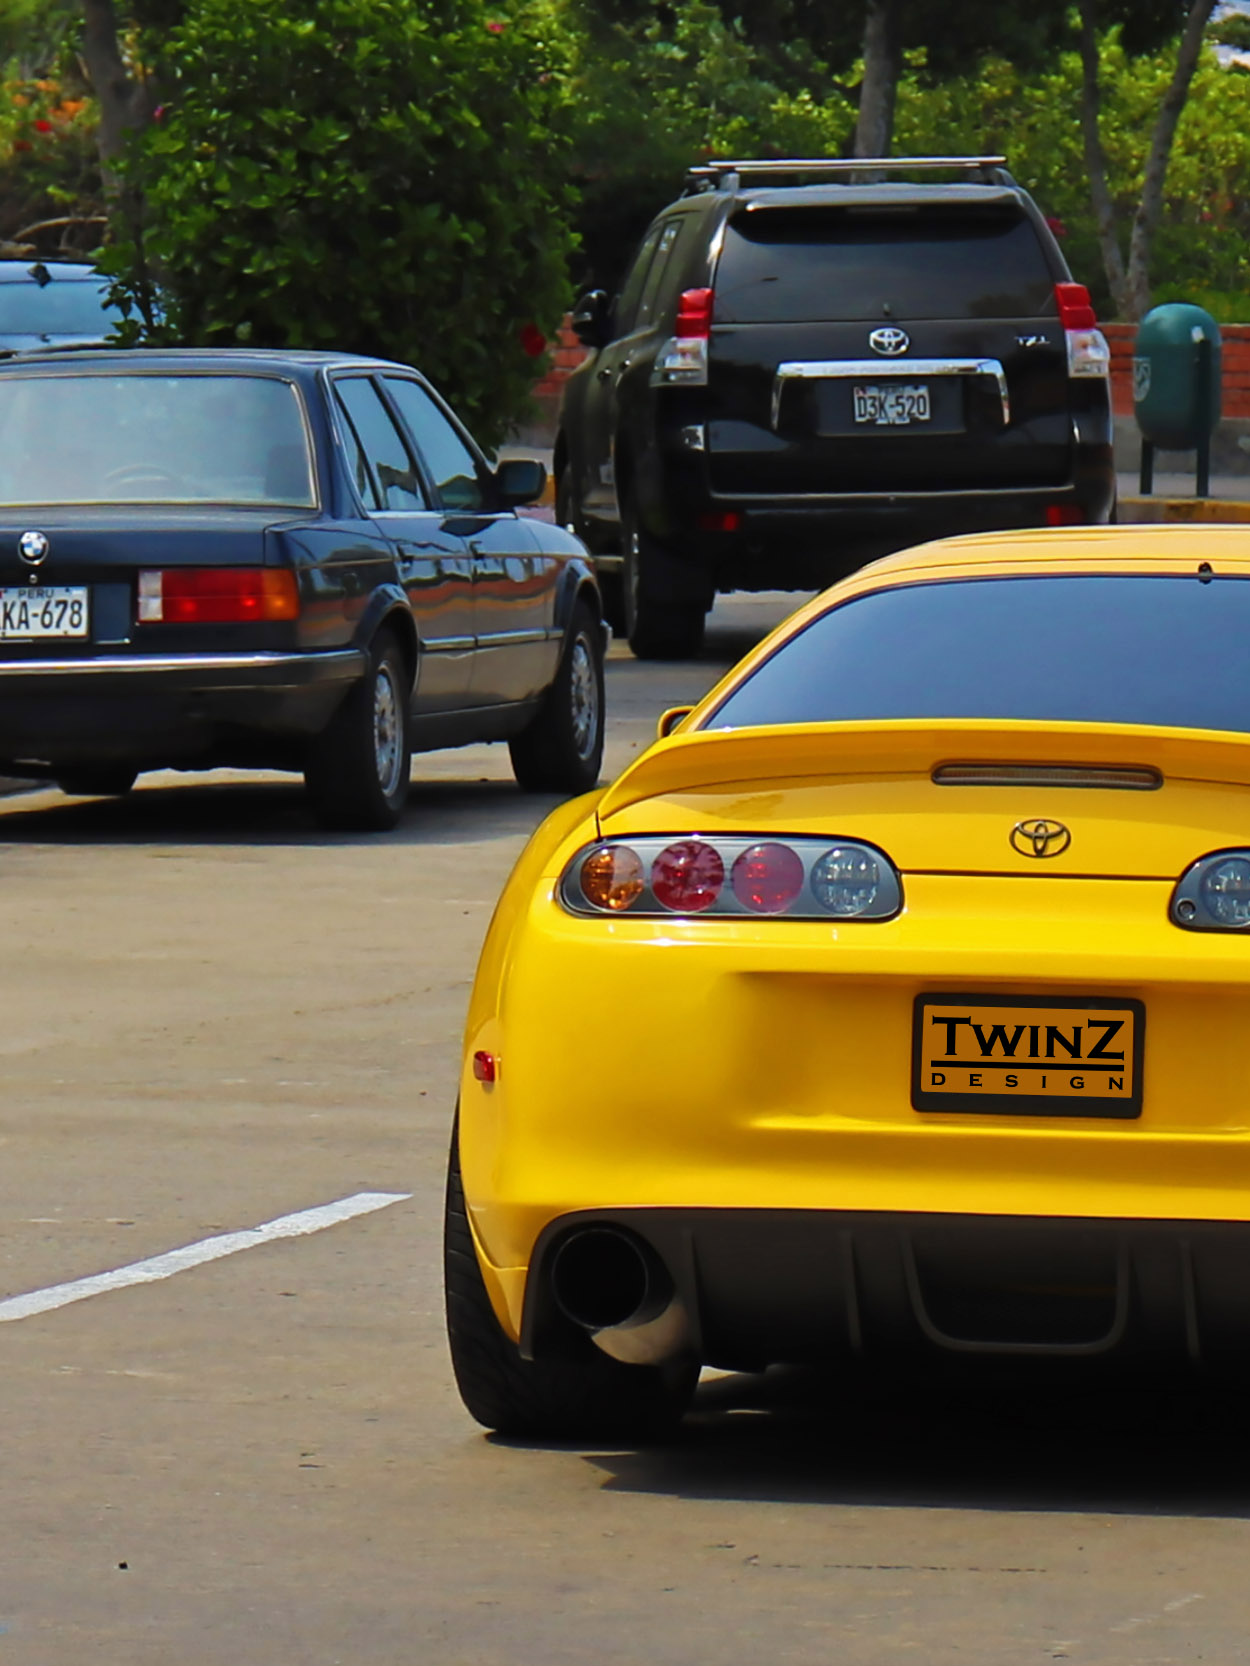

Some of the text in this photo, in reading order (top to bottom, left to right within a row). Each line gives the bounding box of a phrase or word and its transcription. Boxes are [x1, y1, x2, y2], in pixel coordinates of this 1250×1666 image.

[857, 394, 927, 418] D3K-520
[18, 588, 55, 599] PERU
[0, 599, 83, 631] KA-678
[931, 1073, 1124, 1091] DESIGN
